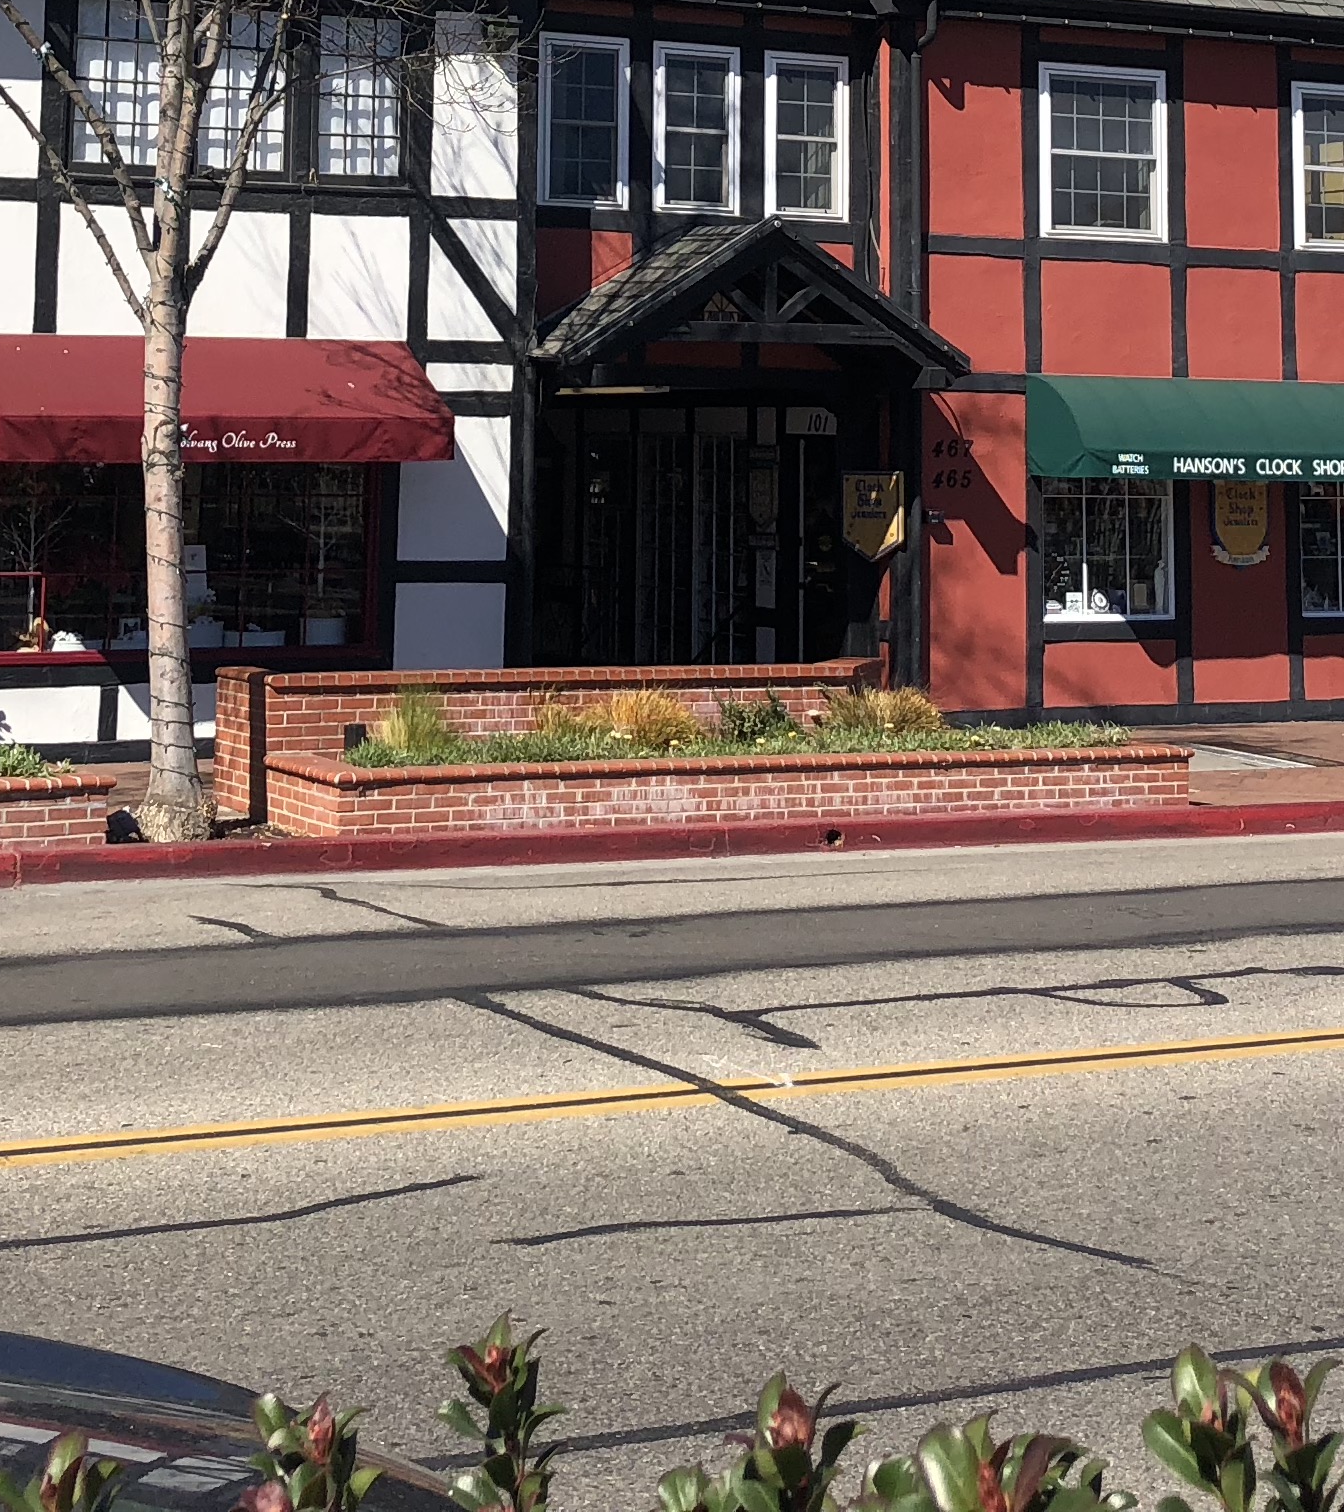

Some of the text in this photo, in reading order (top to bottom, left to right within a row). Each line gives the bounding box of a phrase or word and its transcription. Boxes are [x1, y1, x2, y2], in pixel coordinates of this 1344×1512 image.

[807, 414, 828, 432] 101
[180, 430, 296, 453] olvang Olive Press
[932, 439, 973, 457] 467
[1118, 453, 1143, 463] WATCH
[1173, 457, 1245, 475] HANSON'S
[1256, 459, 1303, 476] CLOCK
[931, 469, 972, 488] 465
[1112, 465, 1149, 475] BATTERIES
